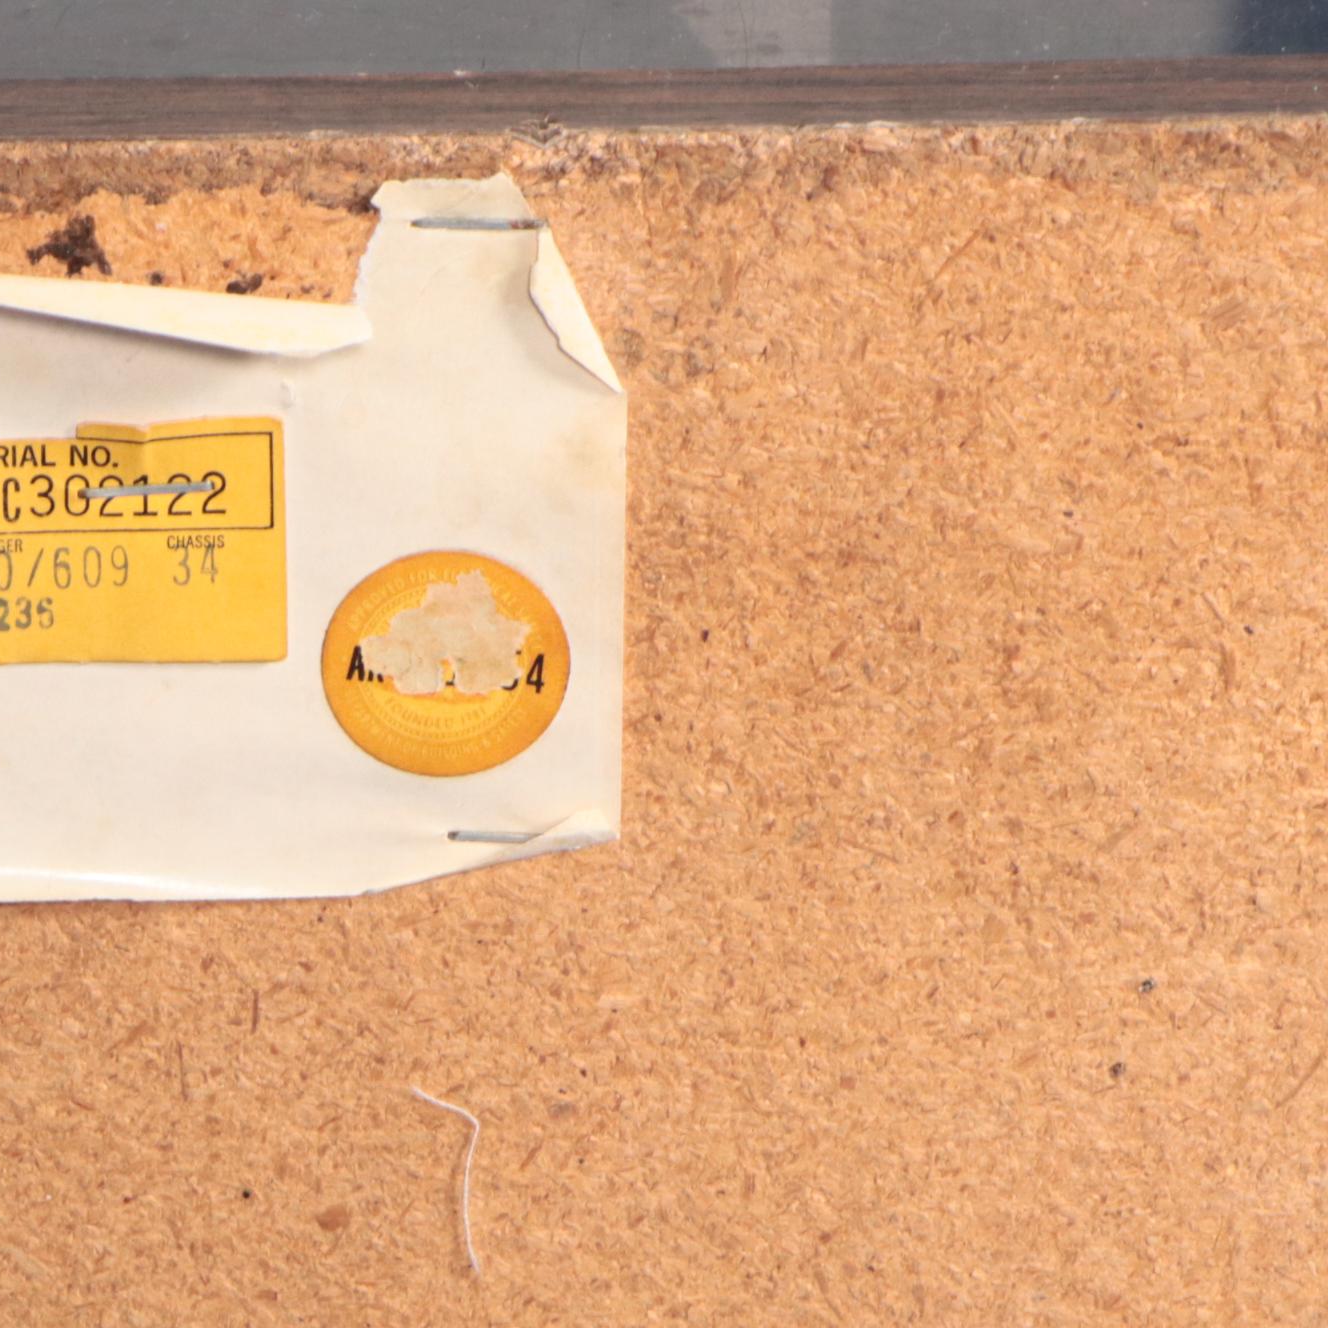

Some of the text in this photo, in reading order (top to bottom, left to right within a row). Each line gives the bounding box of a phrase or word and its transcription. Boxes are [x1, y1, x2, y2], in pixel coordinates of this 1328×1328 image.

[69, 444, 119, 468] NO.
[1, 471, 228, 523] C302122
[166, 534, 226, 550] CHASSIS
